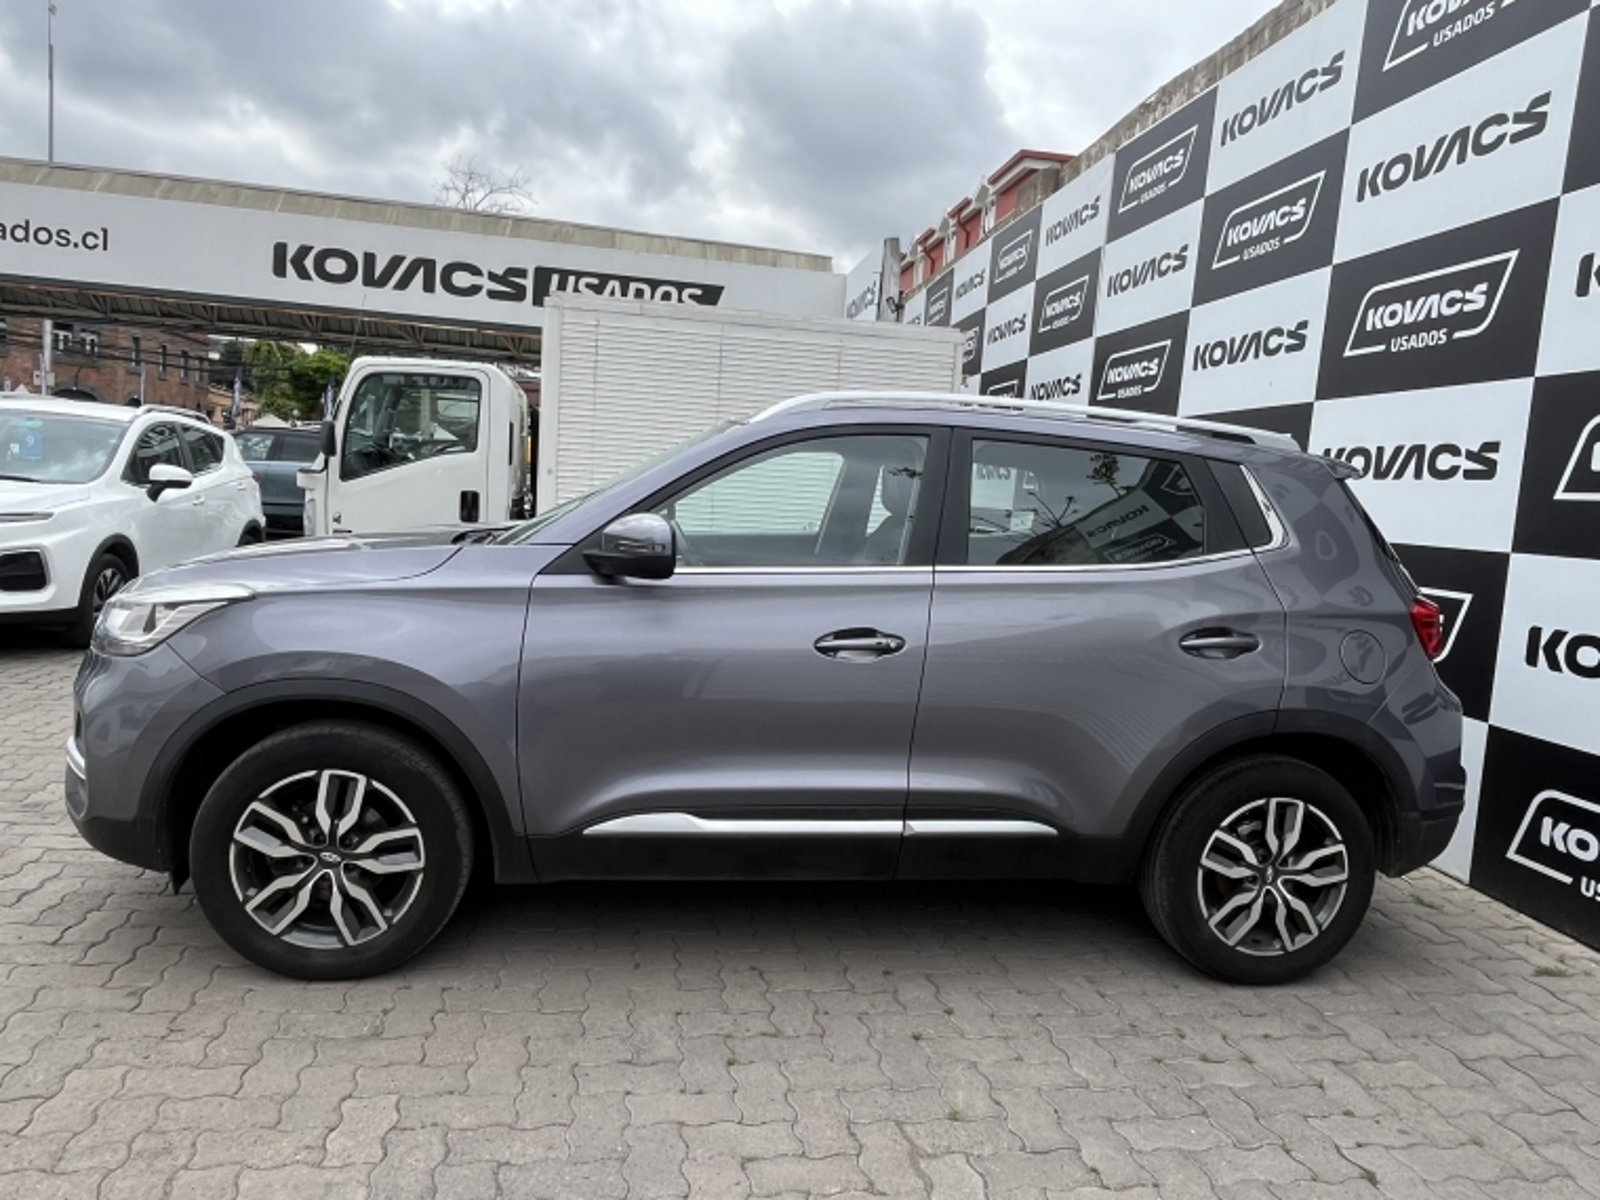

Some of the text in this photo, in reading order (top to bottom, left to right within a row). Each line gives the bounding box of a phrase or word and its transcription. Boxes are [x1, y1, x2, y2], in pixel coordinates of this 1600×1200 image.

[1433, 1, 1495, 47] USADOS
[1220, 50, 1345, 147] KOVACS
[1357, 90, 1552, 202] KOVACS
[1128, 148, 1184, 194] KOVACS
[1045, 195, 1099, 247] KOVACS
[1227, 197, 1306, 247] KOVACS
[272, 240, 527, 304] KOVACS
[1107, 244, 1189, 297] KOVACS
[1243, 236, 1281, 261] USADOS
[1366, 282, 1489, 331] KOVACS
[1192, 320, 1309, 371] KOVACS
[1391, 328, 1448, 352] USADOS
[1030, 373, 1082, 401] KOVACS
[1106, 357, 1160, 384] KOVACS
